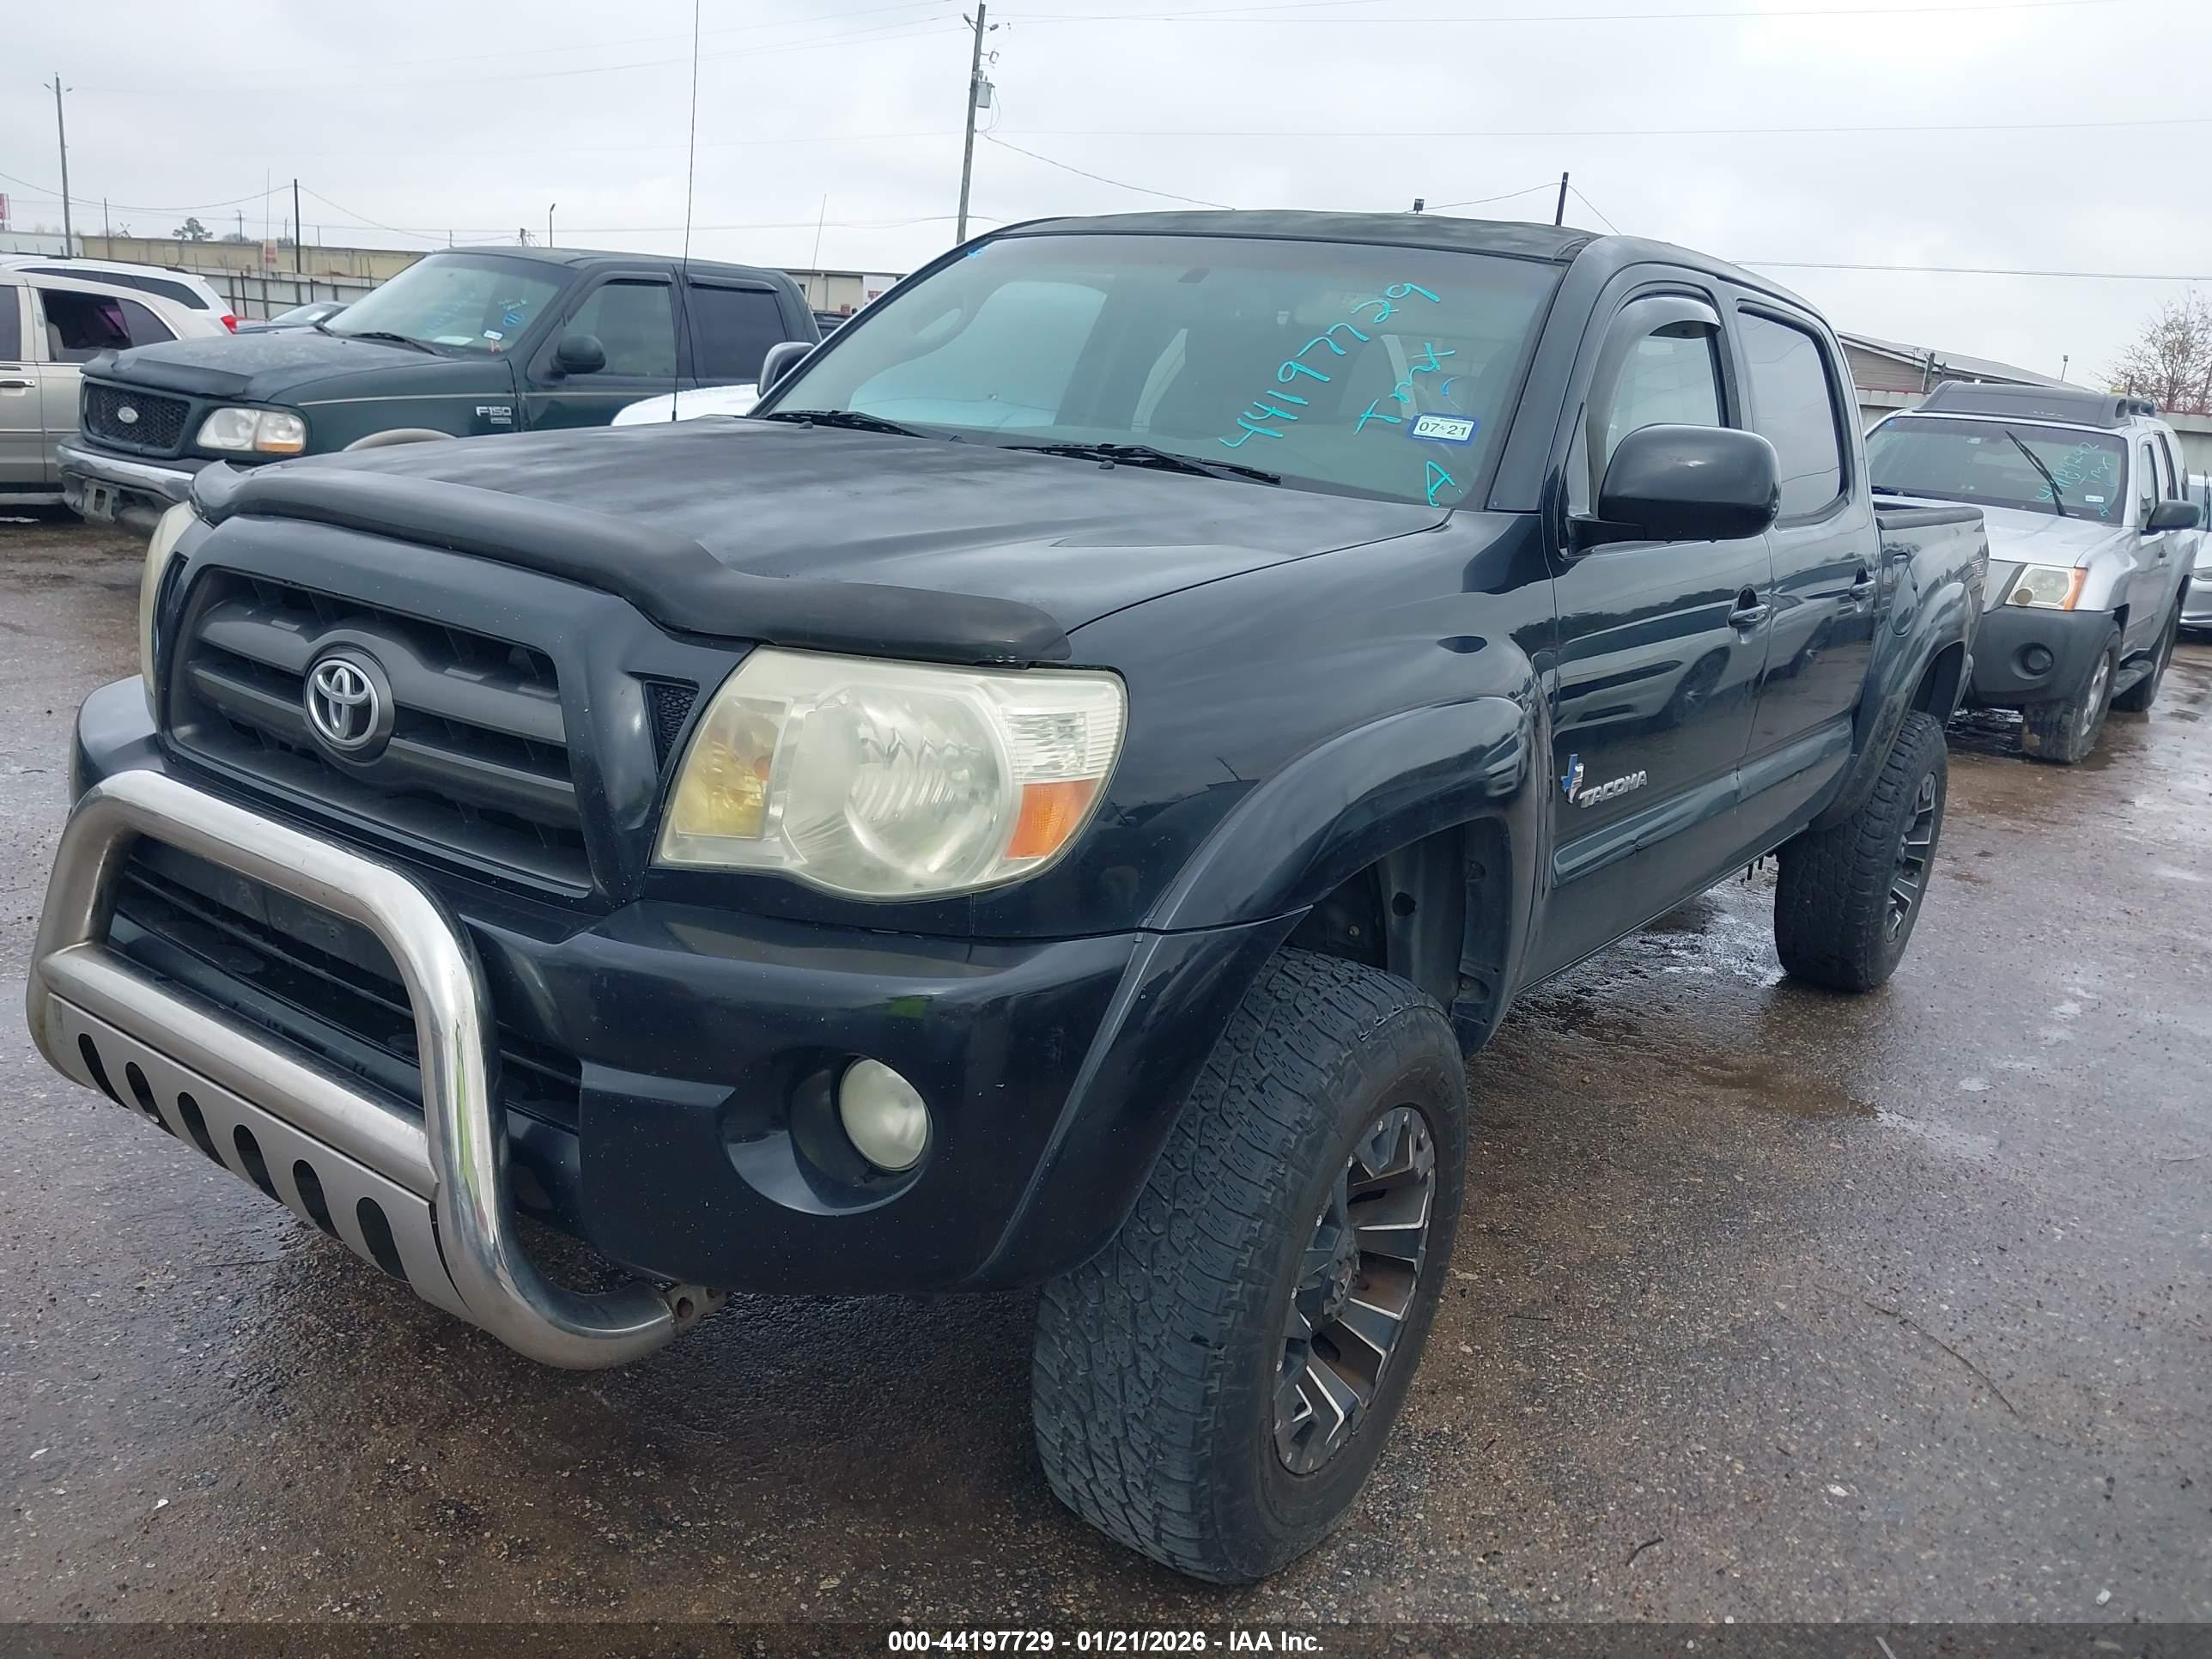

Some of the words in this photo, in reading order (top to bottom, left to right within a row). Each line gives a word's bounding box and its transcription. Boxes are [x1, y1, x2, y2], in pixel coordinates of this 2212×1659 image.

[1218, 282, 1441, 448] 44197729
[476, 405, 512, 416] F150
[1425, 459, 1456, 507] A
[1577, 770, 1649, 809] TACOMA
